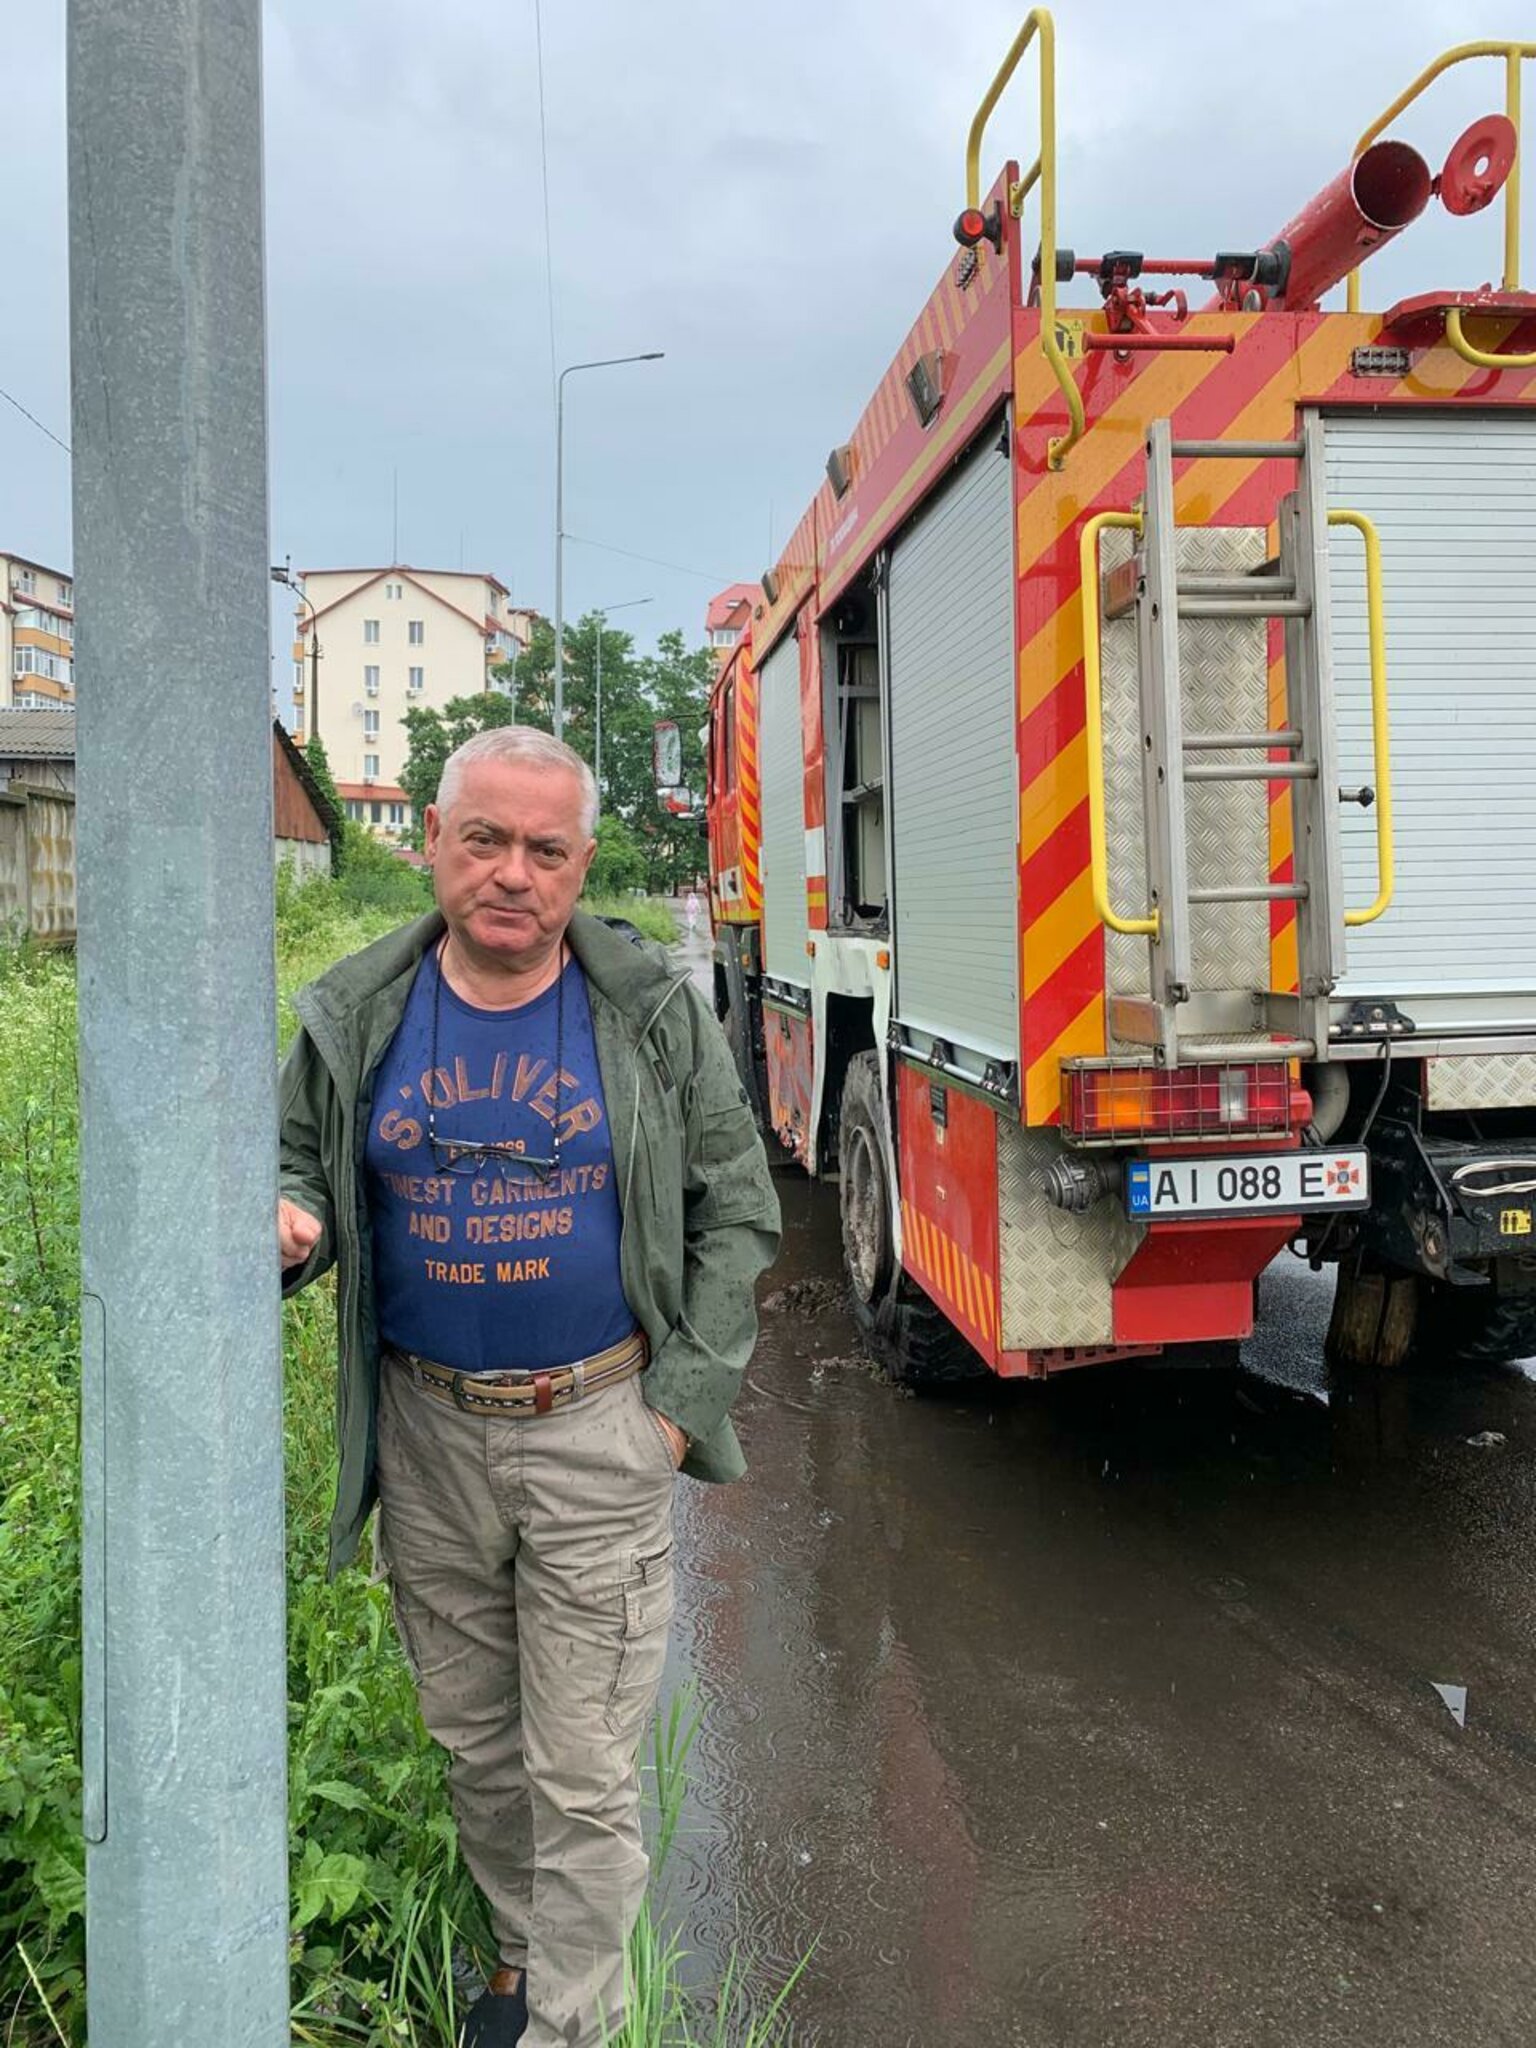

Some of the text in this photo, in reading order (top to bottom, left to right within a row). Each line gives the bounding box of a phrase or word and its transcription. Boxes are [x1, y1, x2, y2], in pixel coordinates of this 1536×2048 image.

[472, 1164, 608, 1206] GARMENTS
[1132, 1196, 1149, 1206] UA
[1154, 1169, 1198, 1205] AI
[1217, 1165, 1281, 1202] 088
[409, 1207, 573, 1244] AND DESIGNS
[425, 1257, 550, 1283] TRADE MARK
